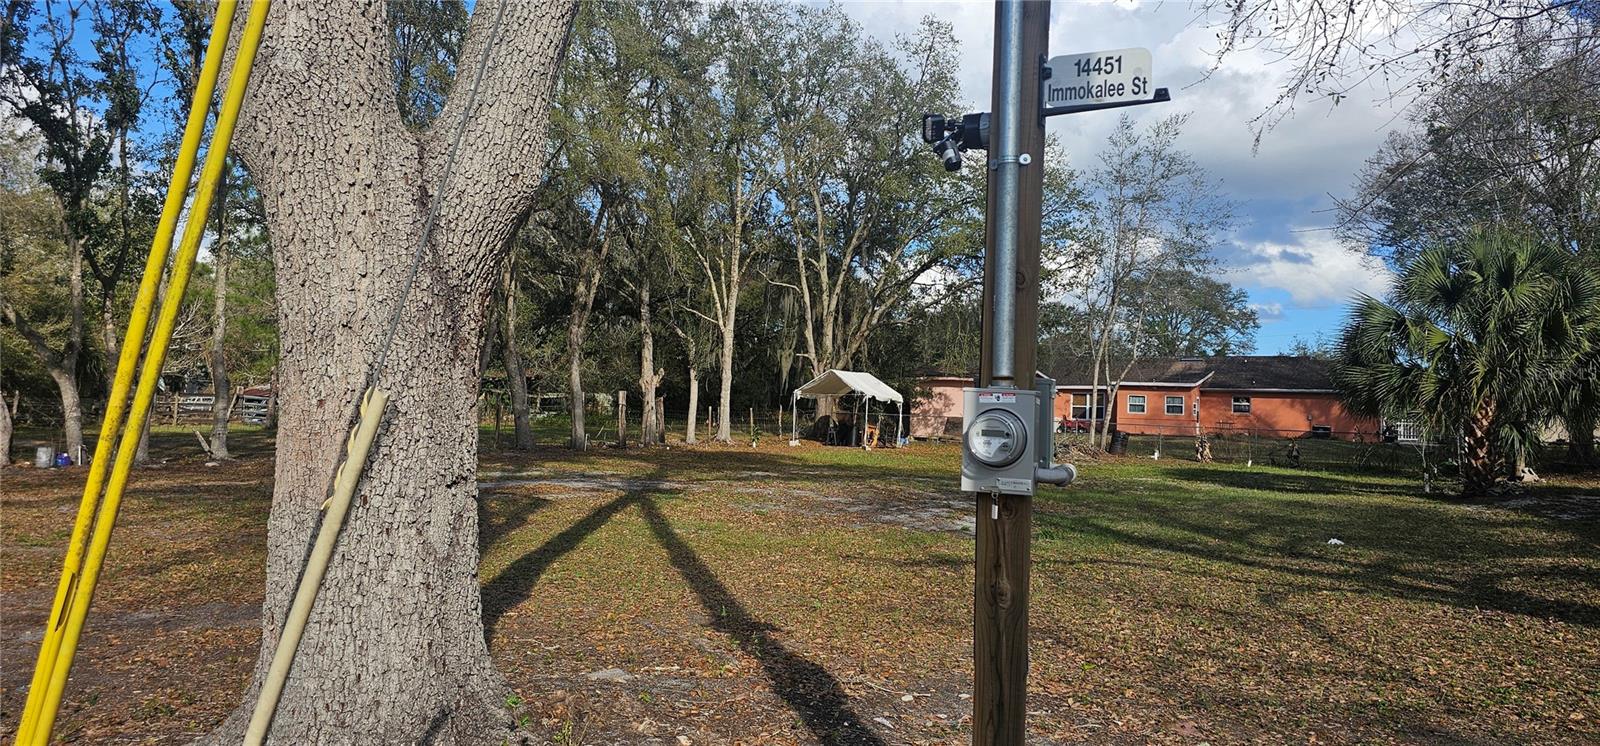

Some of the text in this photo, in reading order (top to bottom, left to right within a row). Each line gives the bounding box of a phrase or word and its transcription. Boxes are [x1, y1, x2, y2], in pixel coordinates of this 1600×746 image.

[1074, 55, 1122, 77] 14451
[1048, 76, 1148, 102] Immokalee St
